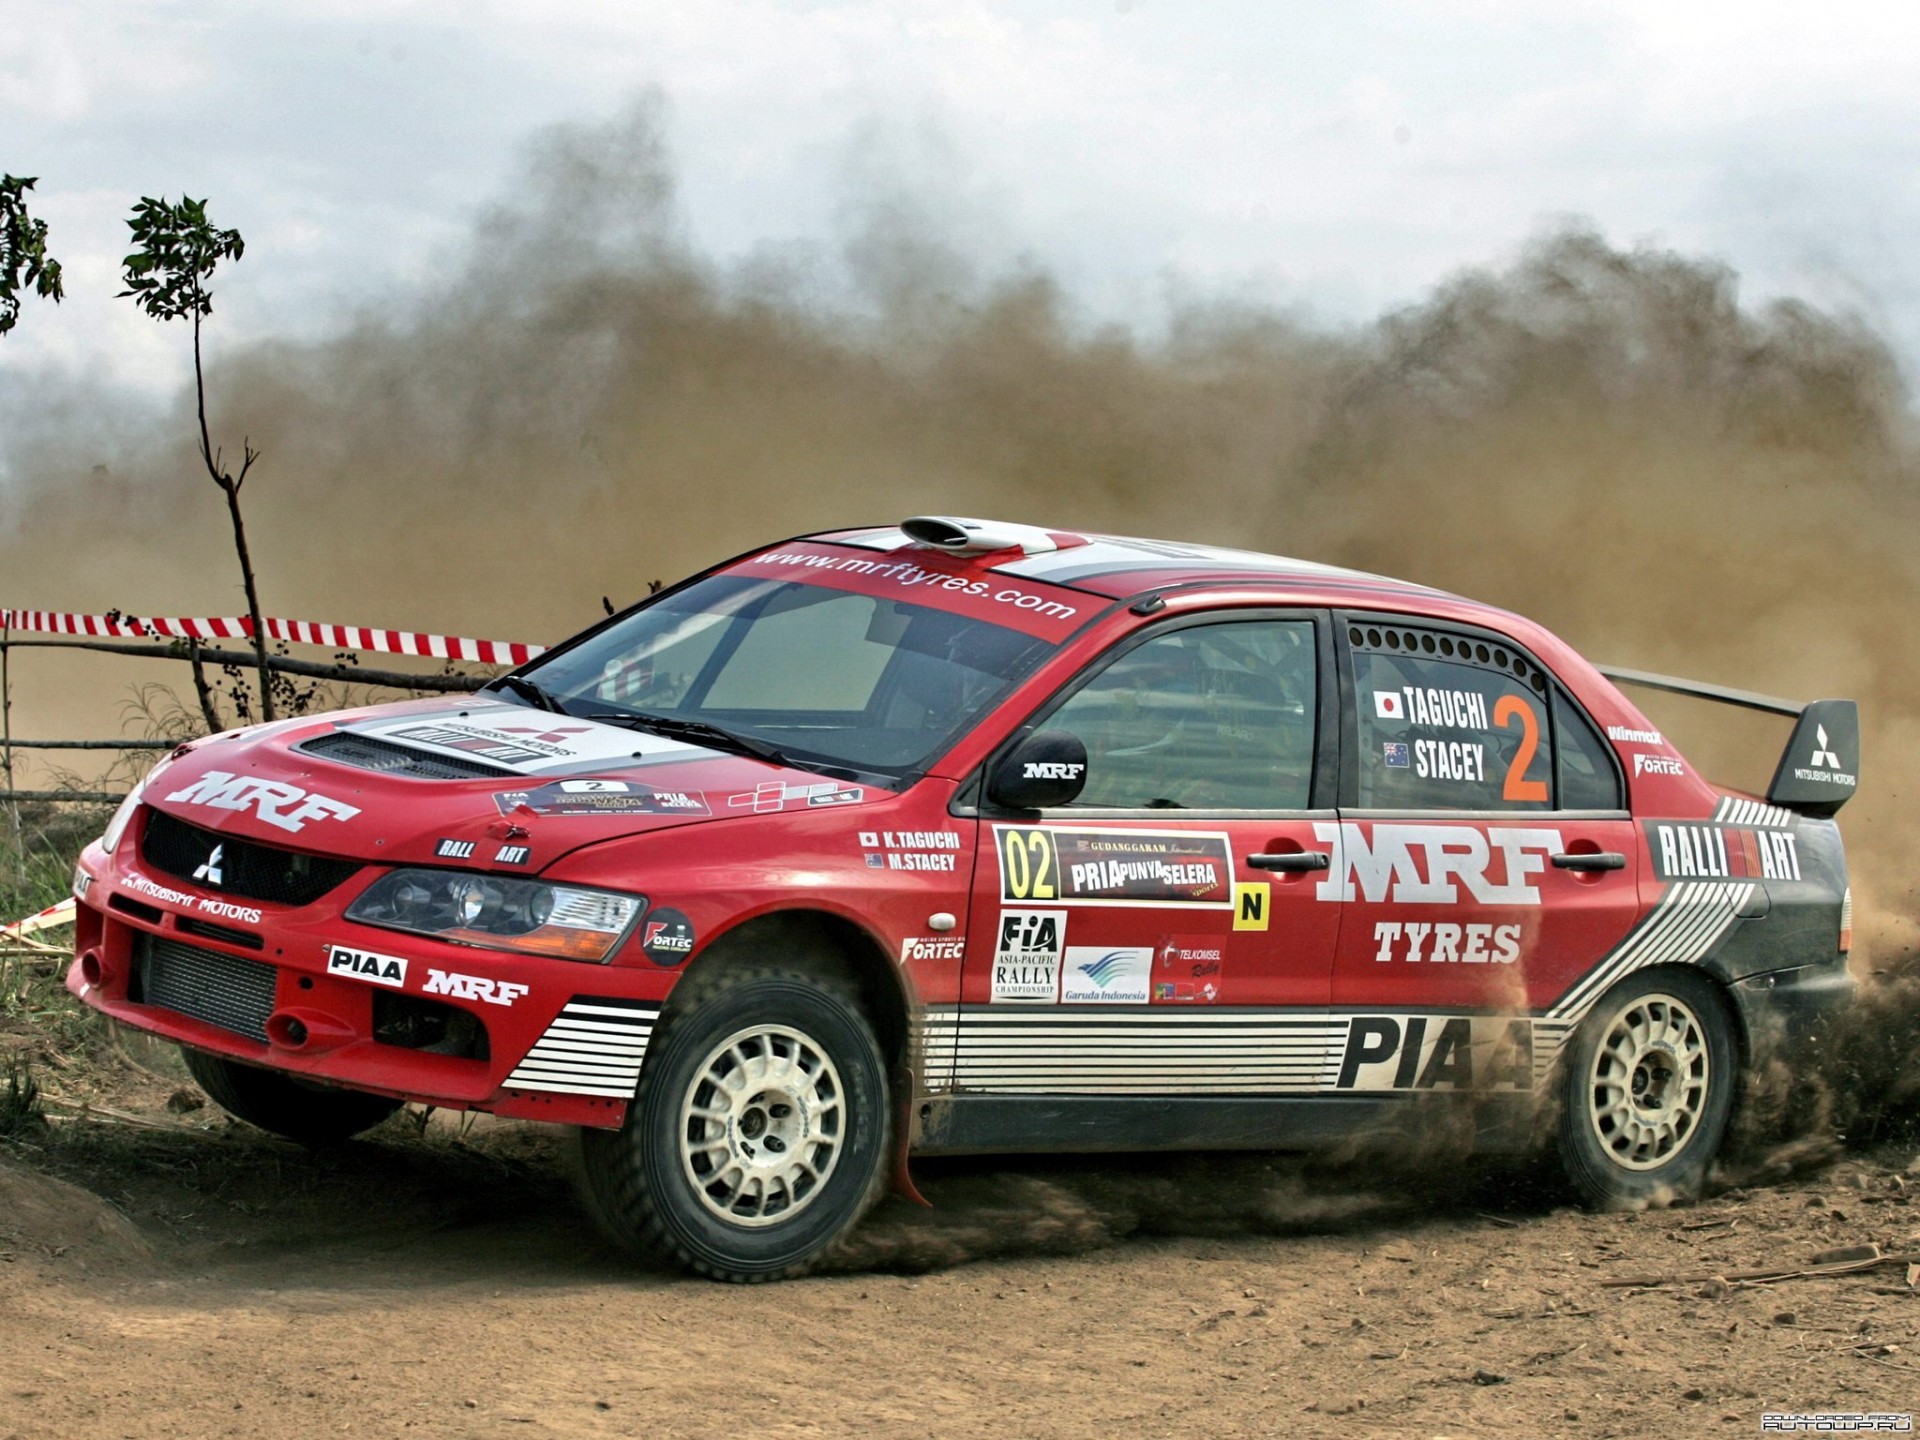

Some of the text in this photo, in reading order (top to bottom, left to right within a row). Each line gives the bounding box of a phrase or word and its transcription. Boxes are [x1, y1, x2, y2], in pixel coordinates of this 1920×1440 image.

[755, 552, 1077, 620] www.mrftyres.com
[1403, 686, 1488, 730] TAGUCHI
[1493, 694, 1548, 801] 2
[1607, 726, 1662, 745] Winmax
[1023, 763, 1084, 779] MRF
[1415, 739, 1484, 781] STACEY
[1633, 754, 1684, 778] FORTEC
[585, 782, 605, 790] 2
[1794, 768, 1856, 786] MITSUBISHI MOTORS
[165, 770, 362, 833] MRF
[495, 846, 528, 863] ART
[883, 832, 960, 849] K.TAGUCHI
[1091, 841, 1131, 852] GUDANG
[1132, 843, 1166, 853] GARAM
[1658, 825, 1801, 881] RALLI ART
[888, 853, 955, 871] M.STACEY
[1006, 830, 1053, 898] 02
[1312, 822, 1564, 905] MRF
[132, 877, 262, 924] MITSUBISHI MOTORS
[1242, 892, 1262, 920] N
[900, 938, 964, 966] FORTEC
[1180, 949, 1221, 960] TELKOMSEL
[1374, 922, 1522, 965] TYRES
[332, 950, 402, 981] PIAA
[998, 954, 1057, 965] ASIA-PACIFIC
[422, 969, 529, 1006] MRF
[996, 966, 1055, 985] RALLY
[995, 986, 1054, 994] CHAMPIONSHIP
[1065, 990, 1146, 1000] Garuda Indonesia
[1336, 1016, 1534, 1090] PIAA
